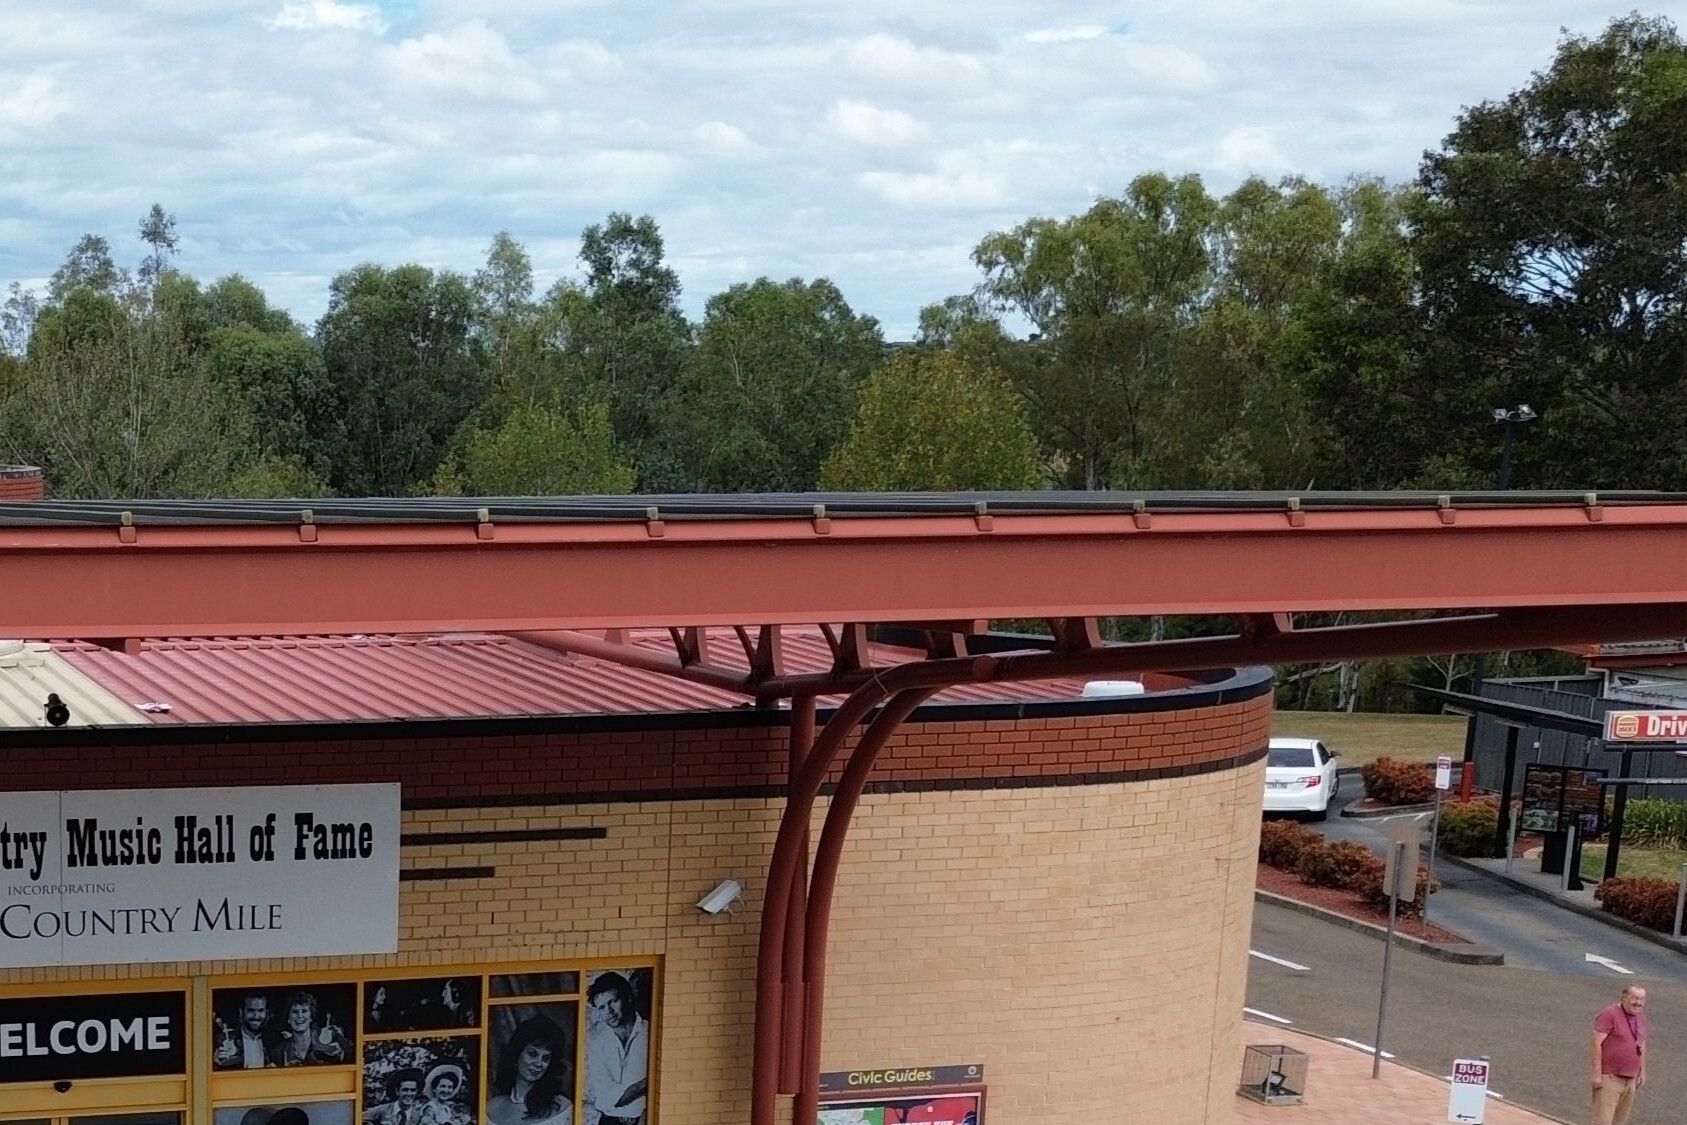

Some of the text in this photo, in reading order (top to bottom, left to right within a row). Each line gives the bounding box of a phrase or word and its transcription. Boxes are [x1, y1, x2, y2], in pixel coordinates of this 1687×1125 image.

[66, 816, 162, 867] Music
[174, 814, 236, 864] Hall
[249, 813, 276, 861] of
[294, 812, 373, 860] Fame
[8, 883, 116, 895] INCORPORATING
[0, 904, 182, 939] COUNTRY
[192, 897, 283, 932] MILE
[848, 1068, 932, 1085] Civic Guides
[1458, 1064, 1483, 1075] BUS
[1454, 1073, 1485, 1085] ZONE
